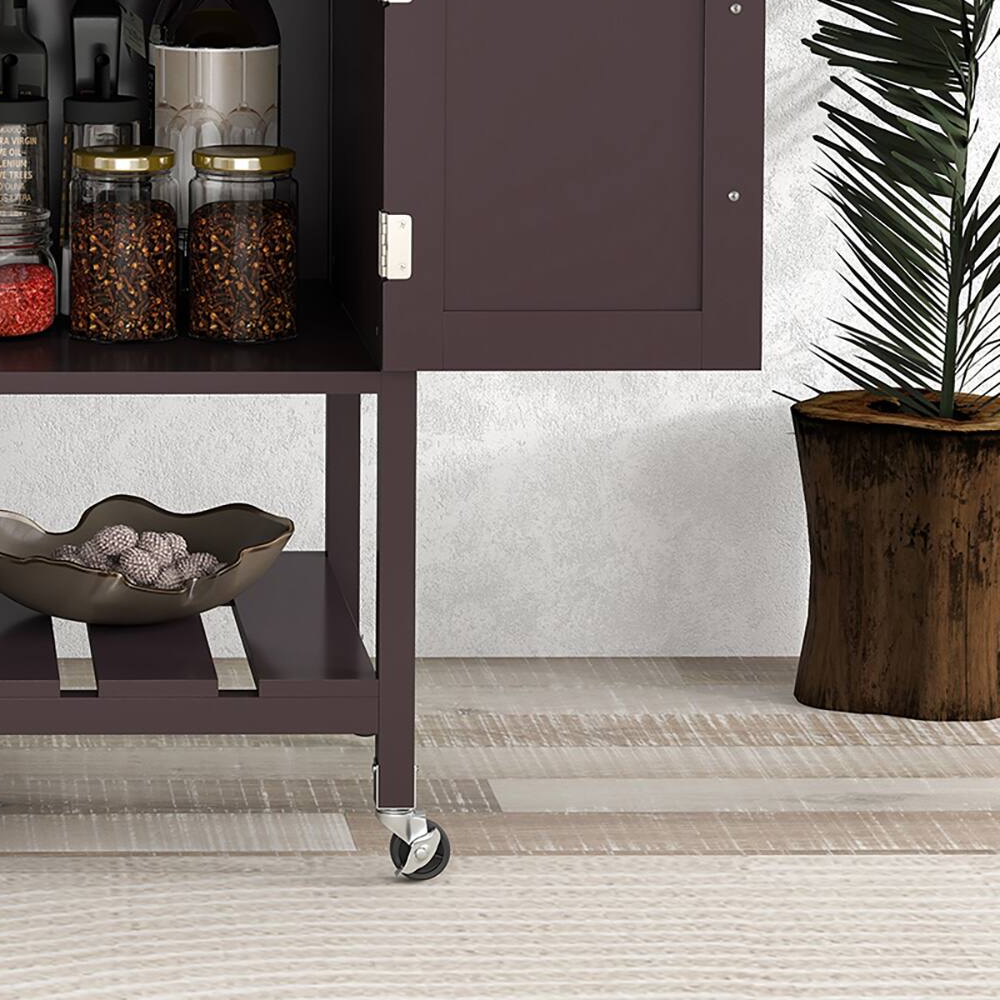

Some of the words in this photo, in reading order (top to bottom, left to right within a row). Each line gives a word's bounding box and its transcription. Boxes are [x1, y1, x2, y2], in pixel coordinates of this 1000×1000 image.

[11, 137, 37, 145] VIRGIN
[9, 148, 22, 157] OIL
[9, 171, 33, 180] TREES
